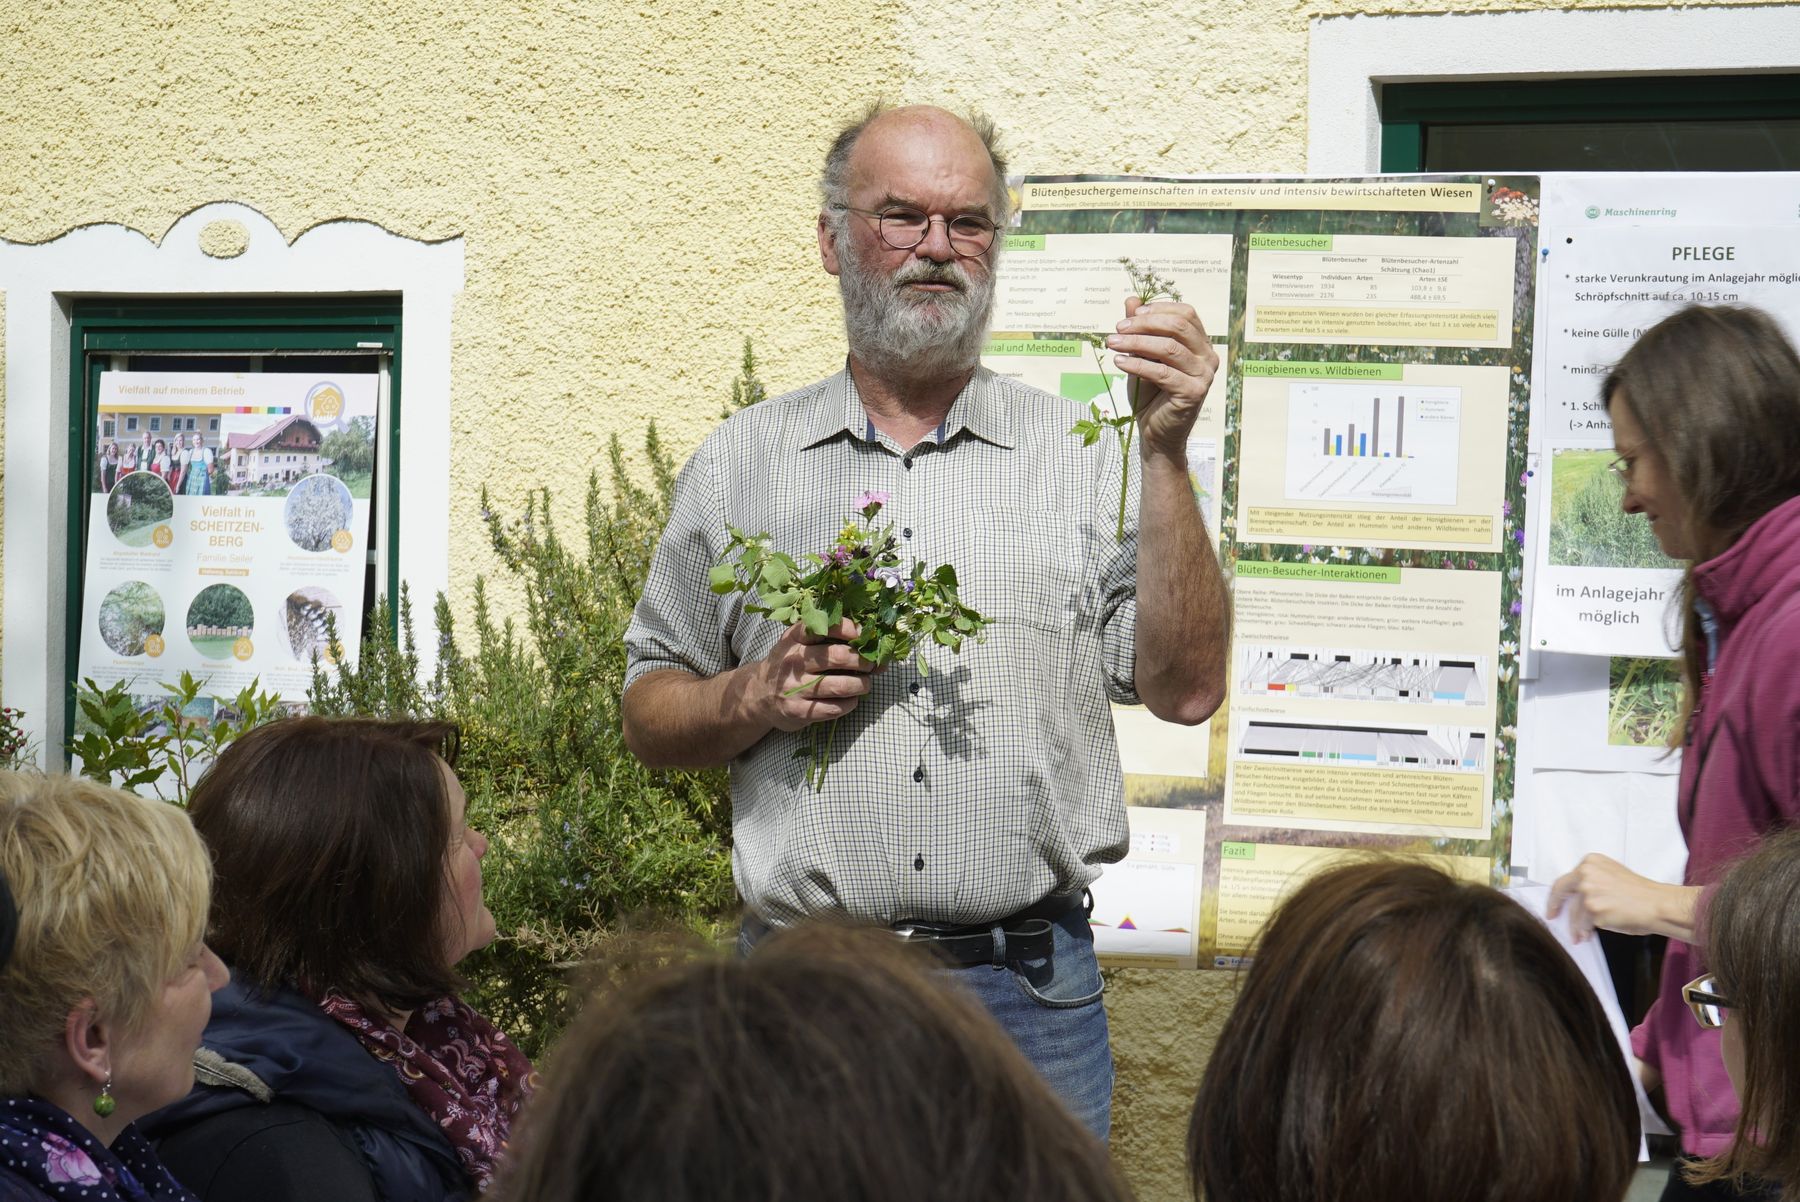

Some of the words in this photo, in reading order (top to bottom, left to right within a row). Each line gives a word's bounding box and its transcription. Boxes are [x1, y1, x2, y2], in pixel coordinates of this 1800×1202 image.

[1031, 186, 1194, 198] Blütenbesuchergemeinschaften
[1198, 187, 1208, 195] in
[1211, 187, 1256, 195] extensiv
[1260, 187, 1280, 196] und
[1283, 187, 1327, 196] intensiv
[1331, 187, 1426, 197] bewirtschafteten
[1430, 187, 1473, 198] Wiesen
[1604, 208, 1677, 217] Maschinenring
[1251, 238, 1328, 248] Blütenbesucher
[1672, 246, 1735, 261] PFLEGE
[1381, 257, 1459, 265] Blütenbesucher-Artenzahl
[1380, 266, 1410, 274] Schätzung
[1272, 273, 1304, 281] Wiesentyp
[1575, 274, 1607, 283] starke
[1610, 274, 1689, 285] Verunkrautung
[1692, 273, 1705, 283] im
[1708, 273, 1766, 285] Anlagejahr
[1575, 291, 1650, 303] Schröpfschnitt
[1652, 291, 1669, 301] auf
[1690, 292, 1720, 301] 10-15
[1571, 329, 1600, 338] keine
[1602, 328, 1630, 338] Gülle
[1006, 344, 1024, 352] und
[1026, 343, 1075, 353] Methoden
[1245, 364, 1307, 376] Honigbienen
[1326, 366, 1382, 377] Wildbienen
[1571, 365, 1600, 374] mind.
[119, 385, 150, 395] Vielfalt
[152, 385, 168, 395] auf
[170, 385, 208, 395] meinem
[210, 386, 245, 396] Betrieb
[1570, 402, 1580, 411] 1.
[201, 506, 241, 517] Vielfalt
[245, 506, 255, 518] in
[190, 520, 265, 533] SCHEITZEN-
[209, 535, 243, 547] BERG
[196, 552, 227, 561] Familie
[1237, 565, 1387, 580] Blüten-Besucher-Interaktionen
[1555, 584, 1576, 598] im
[1579, 584, 1665, 603] Anlagejahr
[1578, 609, 1640, 625] möglich
[1223, 846, 1246, 856] Fazit
